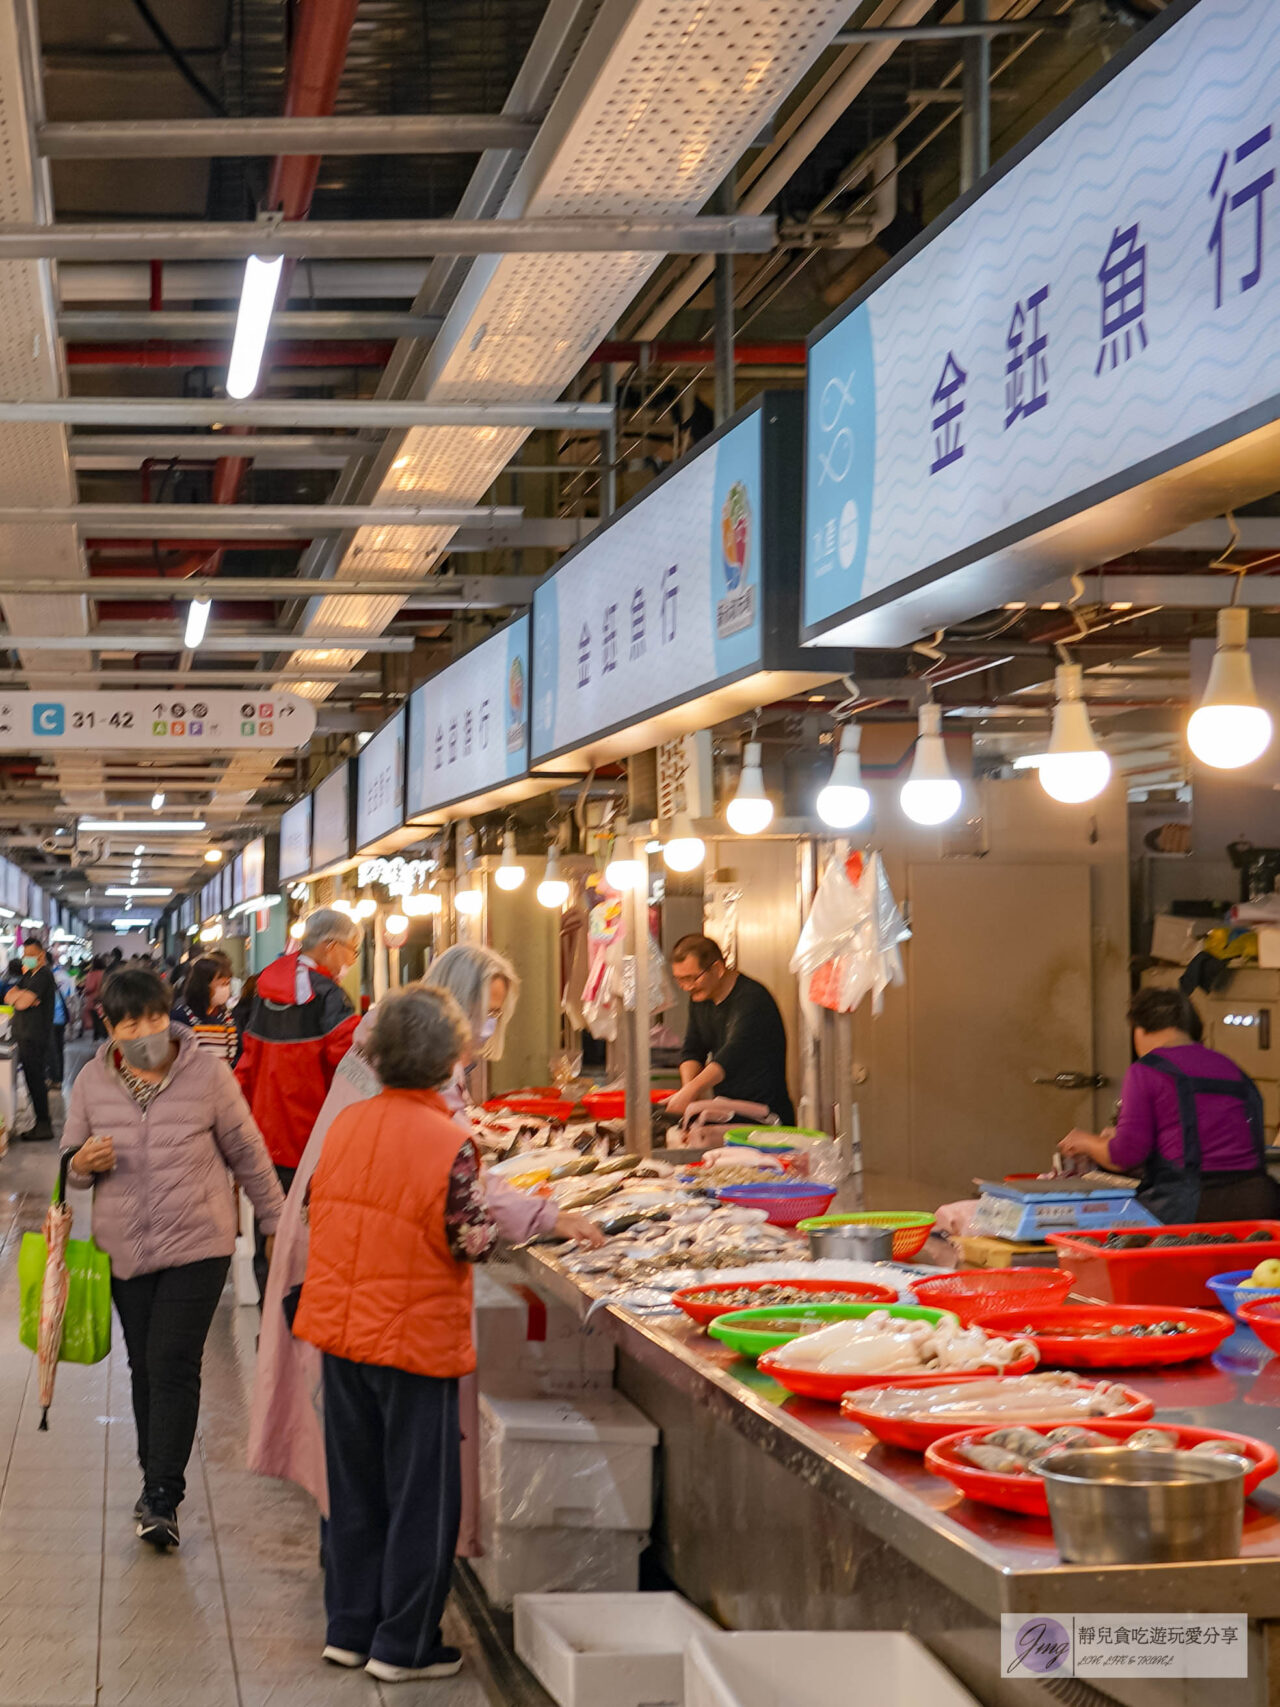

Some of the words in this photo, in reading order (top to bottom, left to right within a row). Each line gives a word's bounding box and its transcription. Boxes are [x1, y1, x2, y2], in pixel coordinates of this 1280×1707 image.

[929, 124, 1276, 476] 金鈺魚行
[577, 563, 679, 690] 金鈺魚行
[39, 710, 57, 730] C
[72, 711, 134, 729] 31-42
